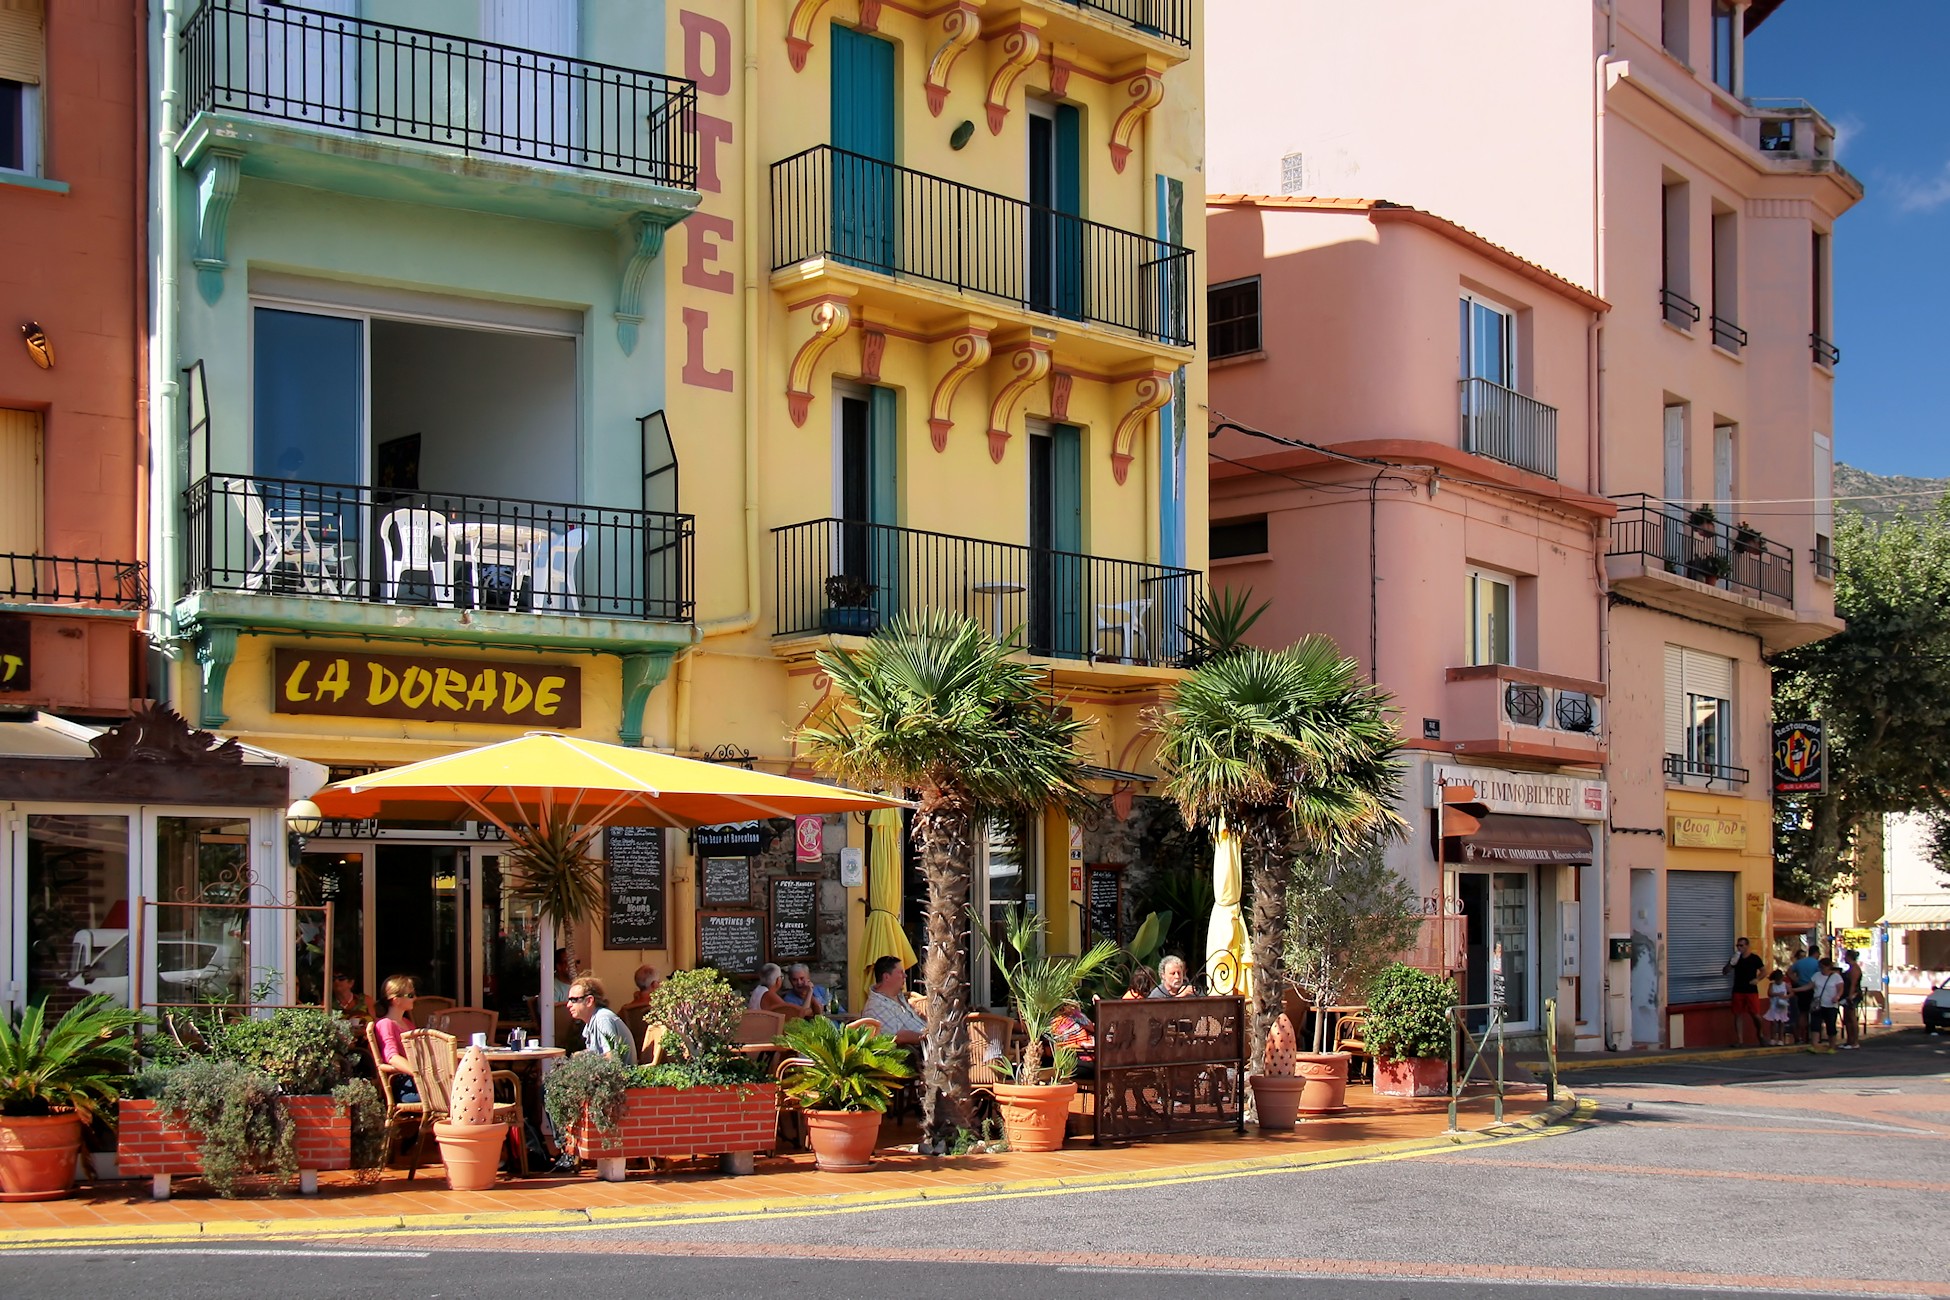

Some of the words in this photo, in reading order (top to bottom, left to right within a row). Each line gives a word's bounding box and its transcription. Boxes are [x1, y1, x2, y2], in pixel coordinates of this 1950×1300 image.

[0, 653, 24, 682] T
[285, 658, 351, 702] LA
[366, 661, 566, 716] DORADE
[1774, 723, 1821, 738] Restaurant
[1435, 776, 1488, 799] GENCE
[1491, 781, 1572, 806] IMMOBILIERE
[1683, 818, 1710, 837] Croq
[1481, 847, 1491, 858] Le
[1508, 848, 1551, 860] IMMOBILIER
[617, 895, 648, 904] HAPPY
